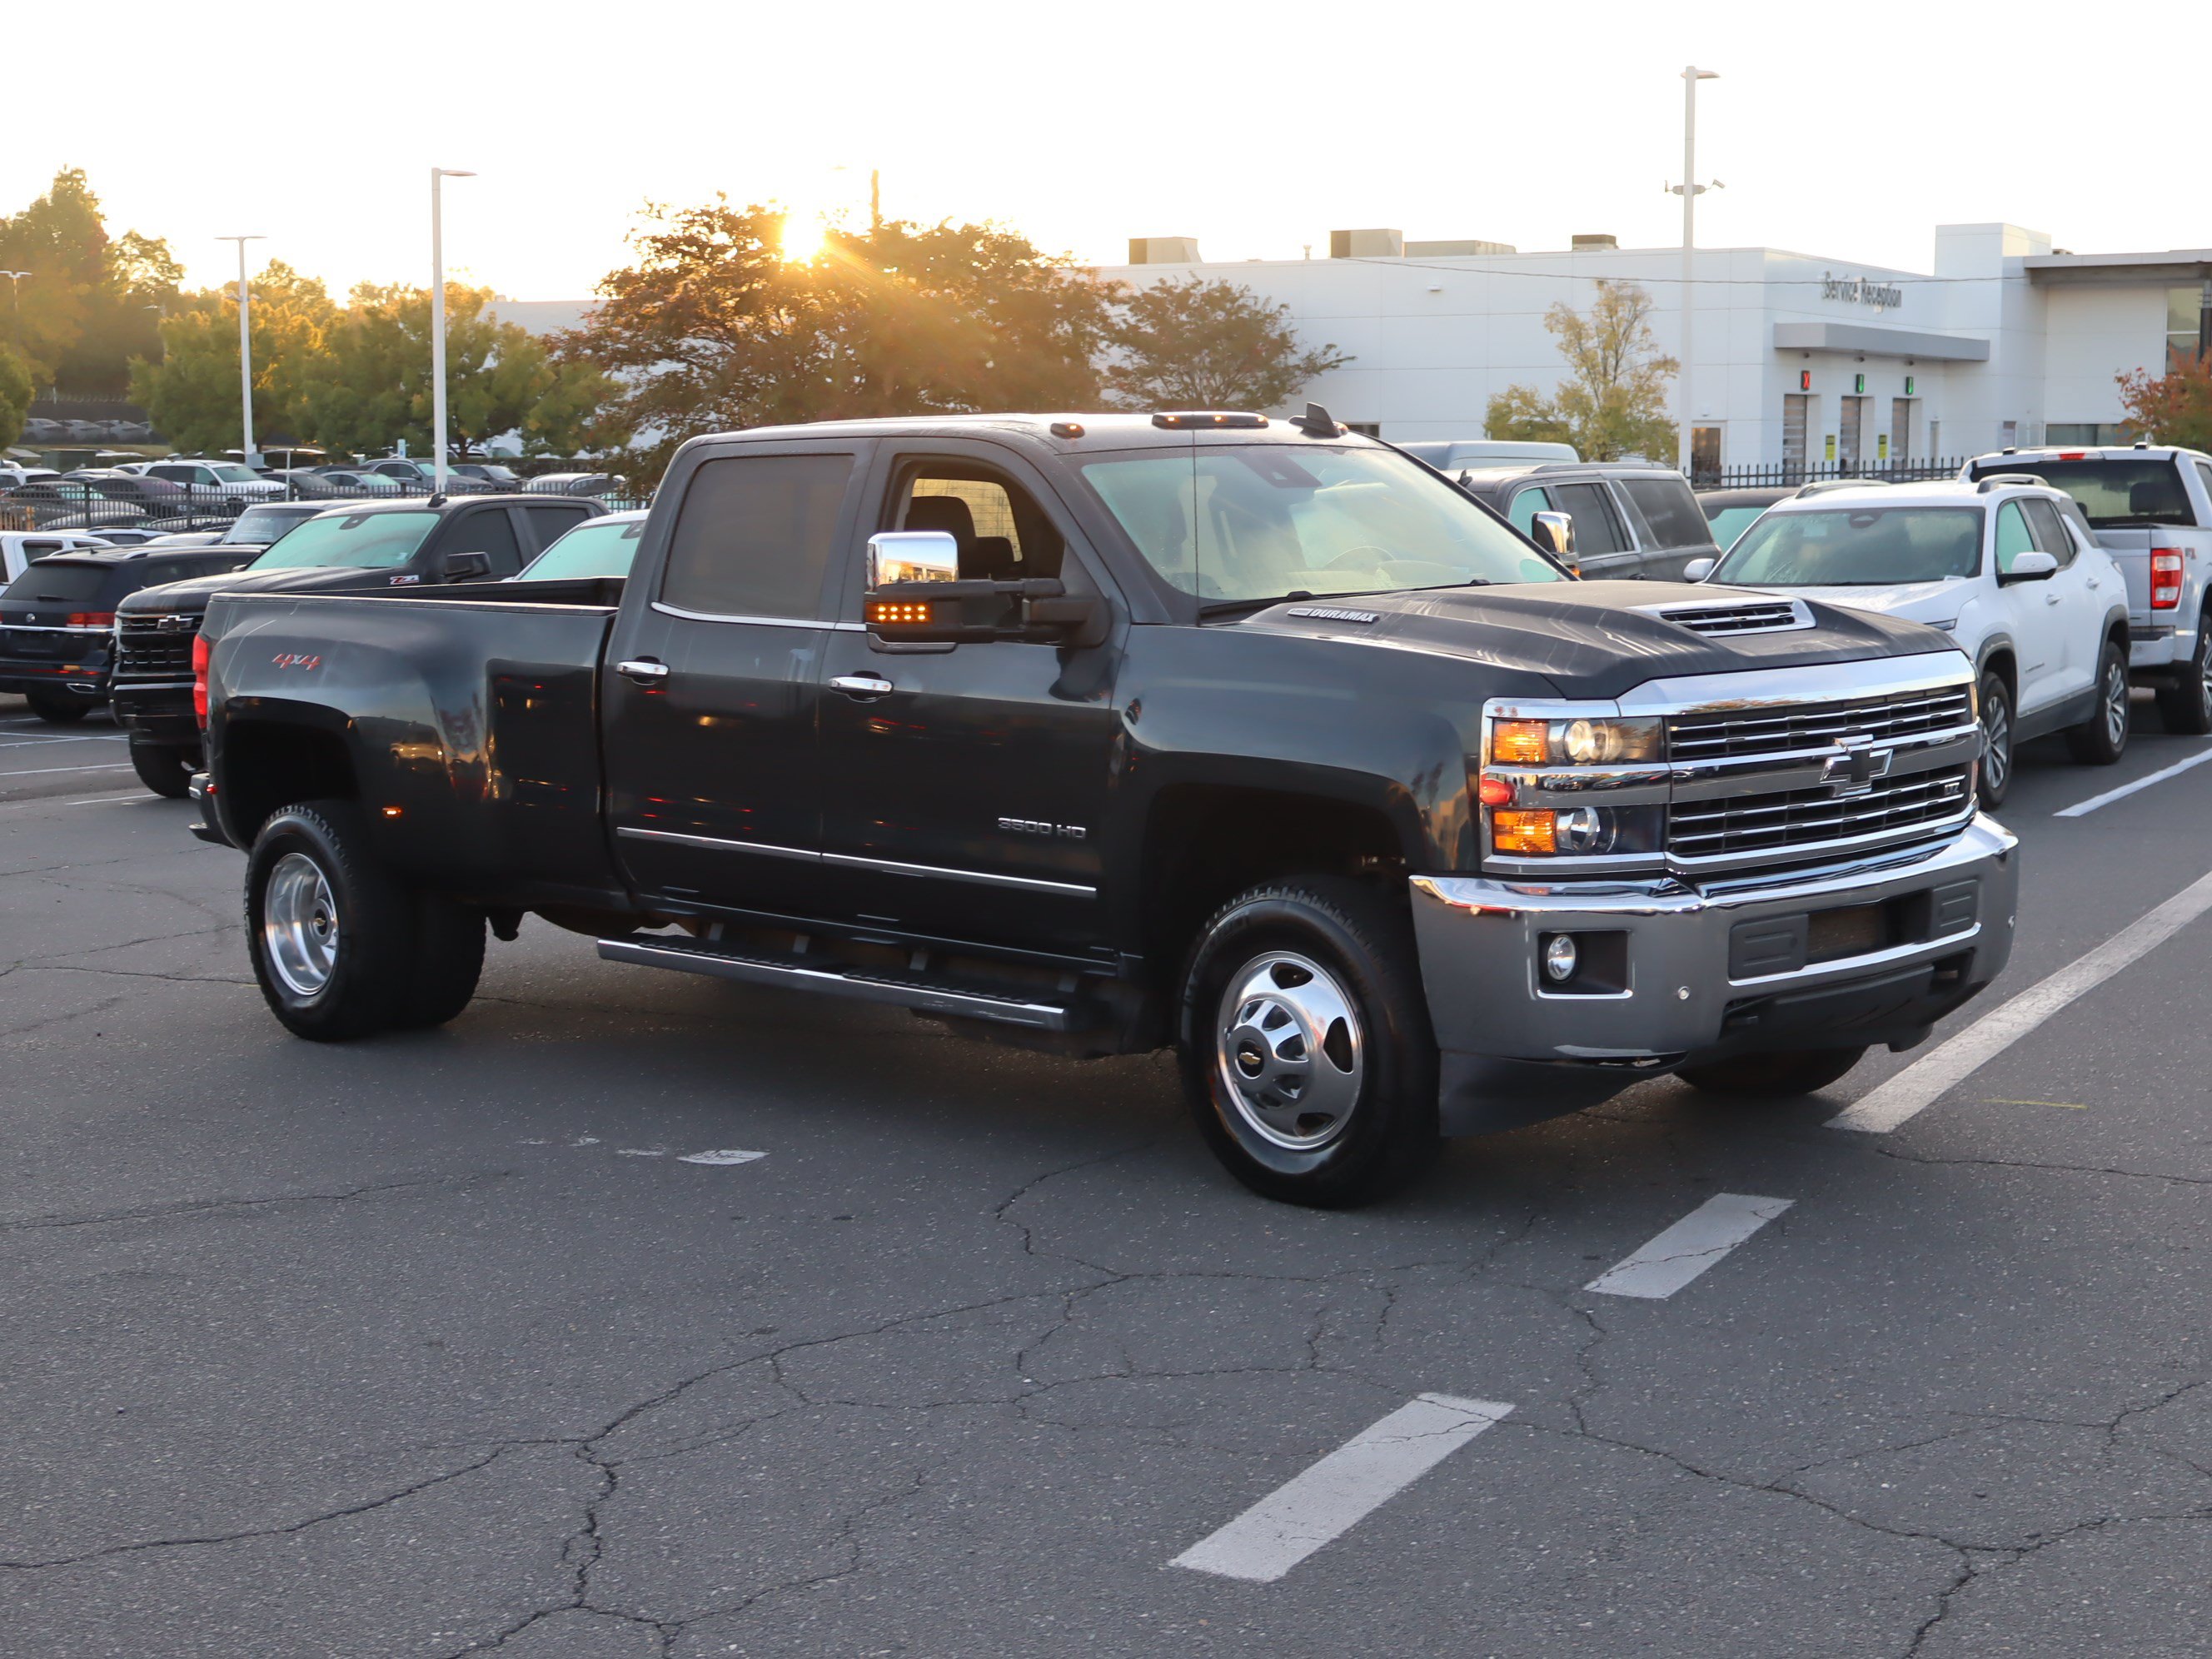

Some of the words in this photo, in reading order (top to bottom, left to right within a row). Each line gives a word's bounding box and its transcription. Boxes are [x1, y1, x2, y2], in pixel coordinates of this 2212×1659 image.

[1821, 270, 1858, 302] Service
[1861, 276, 1901, 312] Reception
[1308, 608, 1379, 622] DURAMAX
[999, 817, 1051, 834] 3500
[1057, 825, 1086, 838] HD
